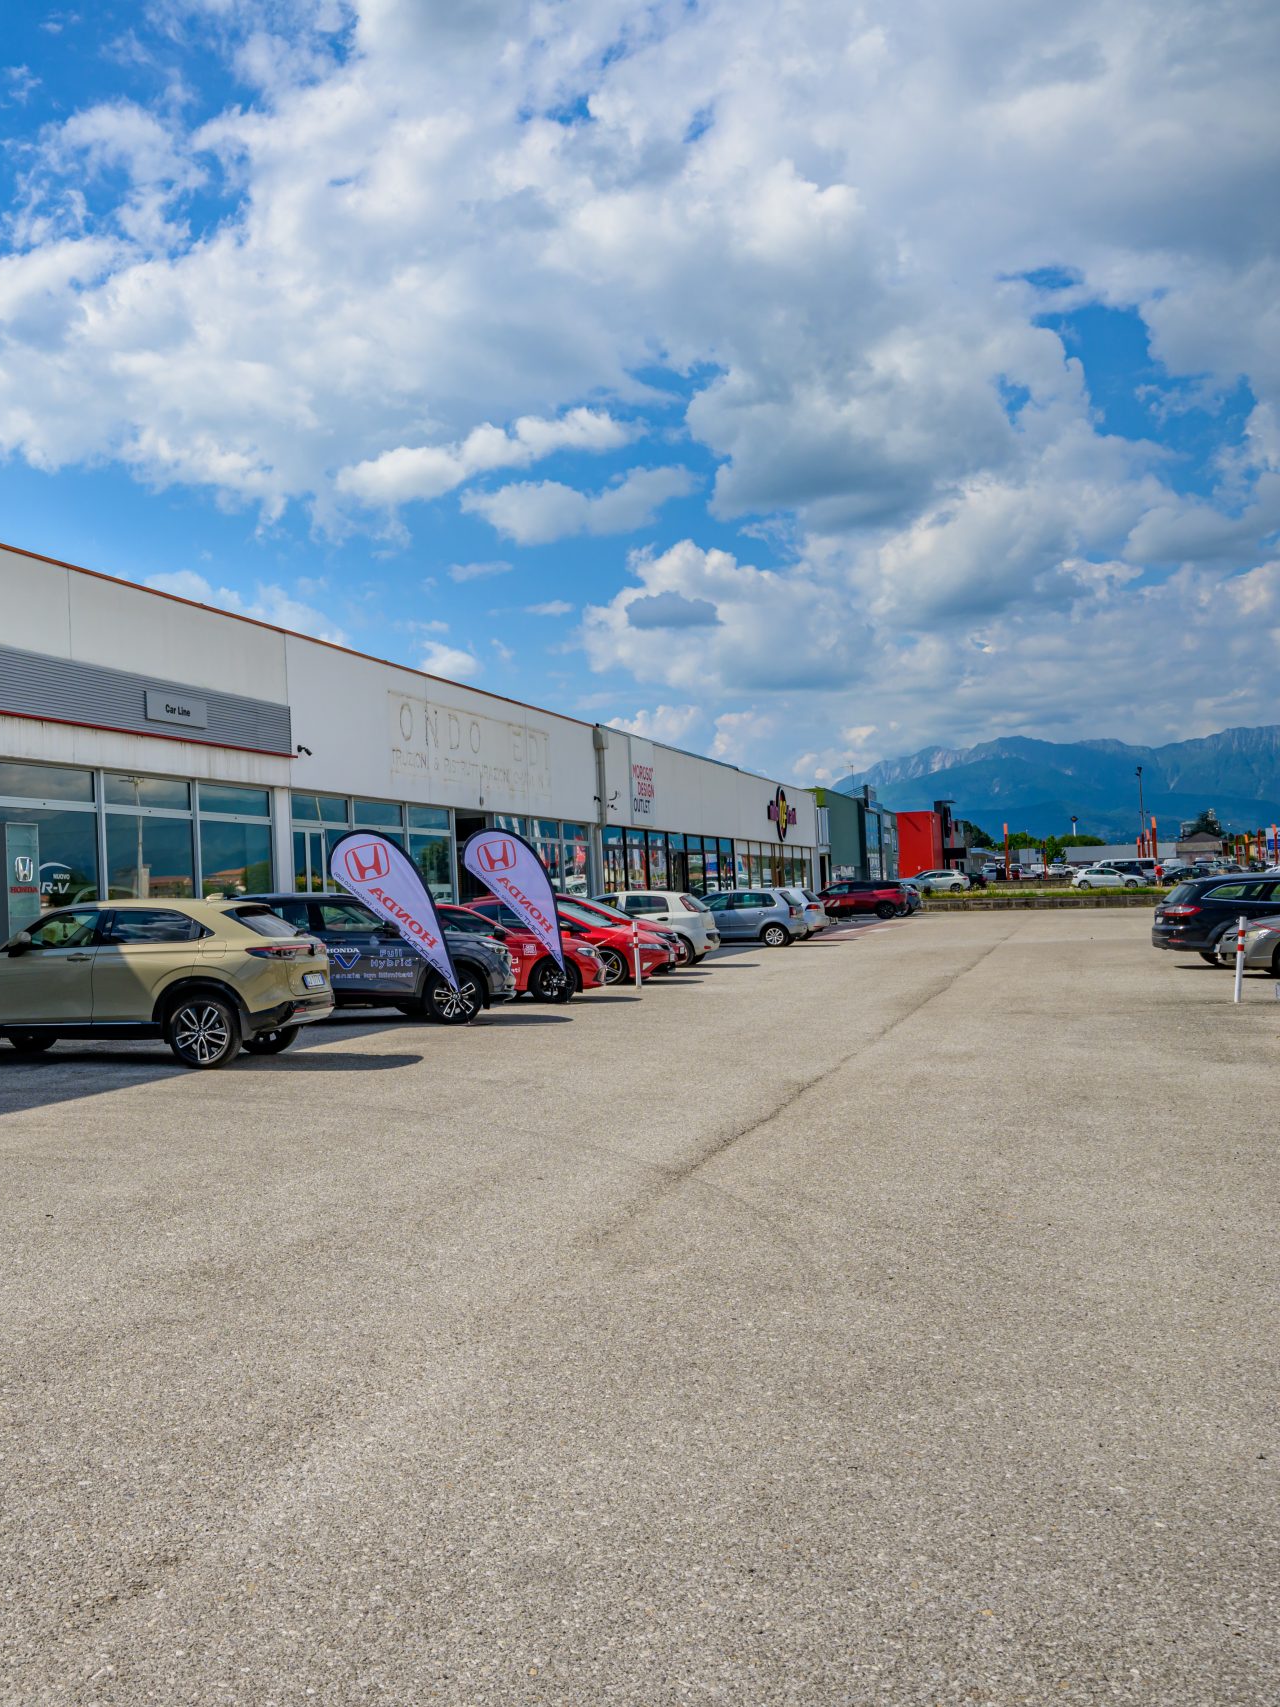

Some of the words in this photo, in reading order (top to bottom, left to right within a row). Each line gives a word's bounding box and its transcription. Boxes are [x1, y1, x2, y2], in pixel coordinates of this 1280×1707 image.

[165, 703, 177, 715] Car
[177, 706, 191, 717] Line
[633, 797, 651, 814] OUTLET
[40, 881, 70, 894] R-V
[380, 949, 402, 957] Full
[329, 953, 361, 969] -V
[370, 959, 412, 969] Hybrid
